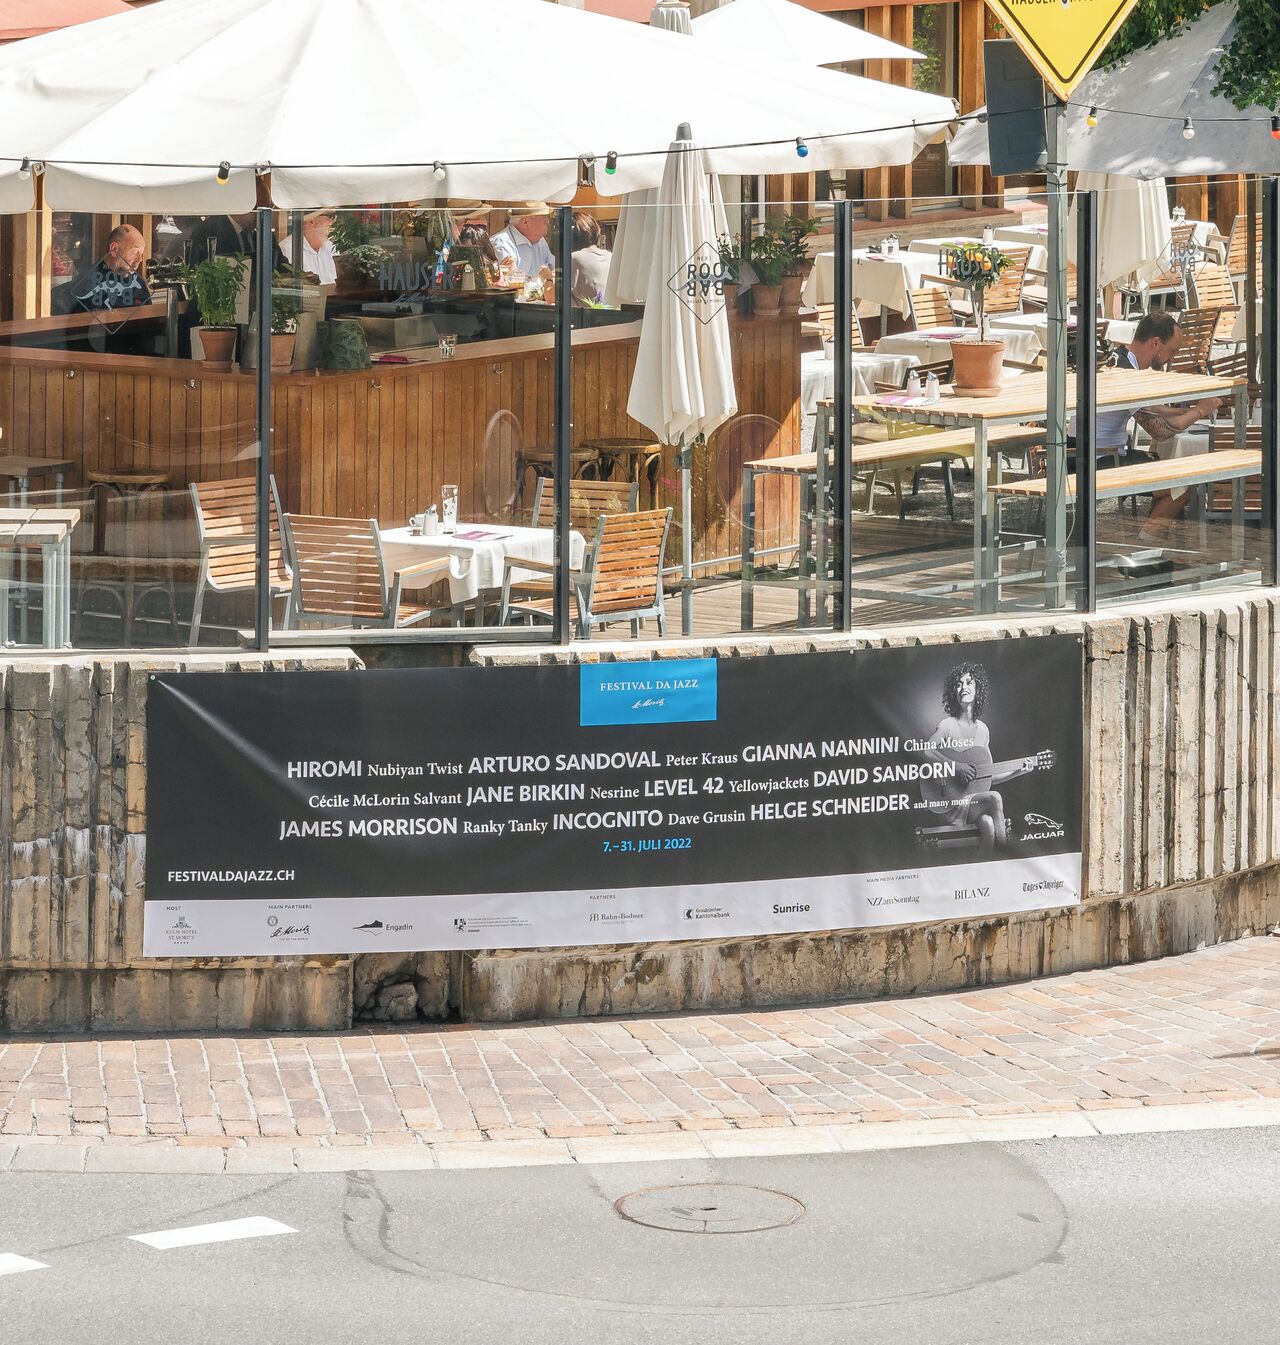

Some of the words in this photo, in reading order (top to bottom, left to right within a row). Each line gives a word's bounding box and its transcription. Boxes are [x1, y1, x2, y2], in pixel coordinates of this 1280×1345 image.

[378, 261, 454, 291] HAUSER
[687, 262, 725, 280] ROO
[686, 280, 725, 297] BAR
[600, 681, 653, 691] FESTIVAL
[656, 680, 671, 689] DA
[673, 679, 699, 690] JAZZ
[287, 760, 362, 778] HIROMI
[367, 763, 423, 779] Nubiyan
[427, 762, 463, 775] Twist
[468, 755, 551, 774] ARTURO
[555, 750, 661, 772] SANDOVAL
[666, 753, 698, 767] Peter
[701, 751, 738, 765] Kraus
[742, 741, 816, 763] GIANNA
[821, 736, 899, 758] NANNINI
[903, 739, 937, 753] China
[940, 736, 974, 749] Moses
[308, 794, 349, 808] Cécile
[353, 793, 410, 807] McLorin
[413, 792, 462, 805] Salvant
[466, 785, 513, 806] JANE
[519, 784, 585, 802] BIRKIN
[590, 786, 640, 800] Nesrine
[644, 777, 698, 797] LEVEL
[702, 776, 724, 794] 42
[728, 777, 809, 796] Yellowjackets
[813, 768, 869, 788] DAVID
[872, 761, 956, 784] SANBORN
[279, 820, 343, 840] JAMES
[348, 817, 457, 837] MORRISON
[462, 820, 505, 836] Ranky
[508, 819, 549, 835] Tanky
[553, 809, 663, 830] INCOGNITO
[668, 813, 700, 826] Dave
[703, 810, 746, 824] Grusin
[750, 800, 807, 821] HELGE
[811, 794, 910, 817] SCHNEIDER
[913, 799, 928, 809] and
[929, 799, 950, 809] many
[1020, 830, 1065, 841] JAGUAR
[637, 839, 661, 853] JULI
[664, 837, 692, 850] 2022
[167, 869, 295, 883] FESTIVALDAJAZZ.CH
[954, 887, 990, 900] BILANZ
[772, 902, 811, 914] Sunrise
[385, 923, 413, 932] Engadin
